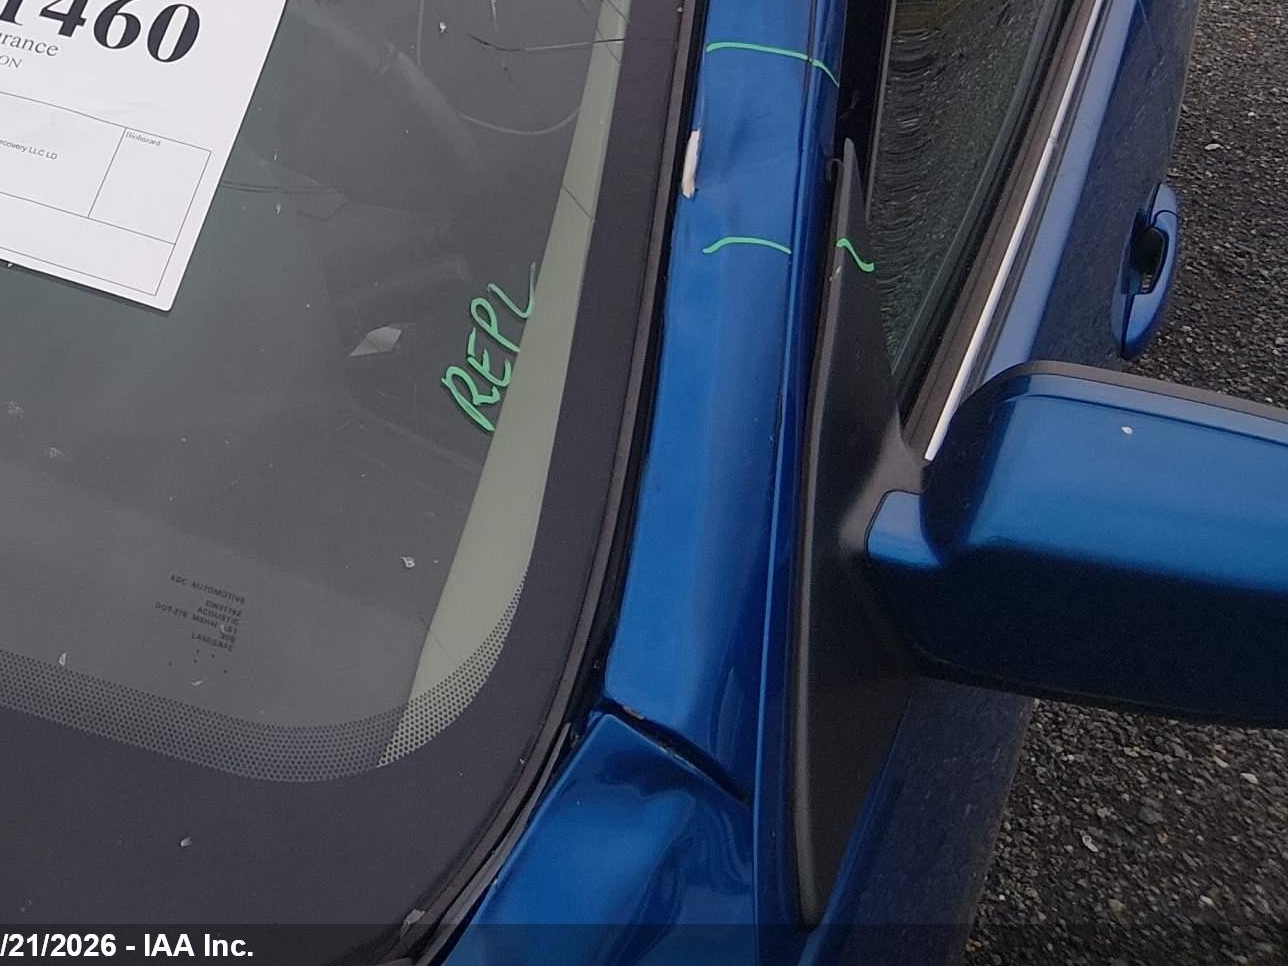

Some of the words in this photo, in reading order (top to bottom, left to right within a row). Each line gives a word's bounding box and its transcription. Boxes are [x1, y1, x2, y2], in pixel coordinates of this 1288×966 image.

[28, 146, 45, 157] LLC
[46, 151, 58, 160] LD
[441, 261, 537, 431] REPL
